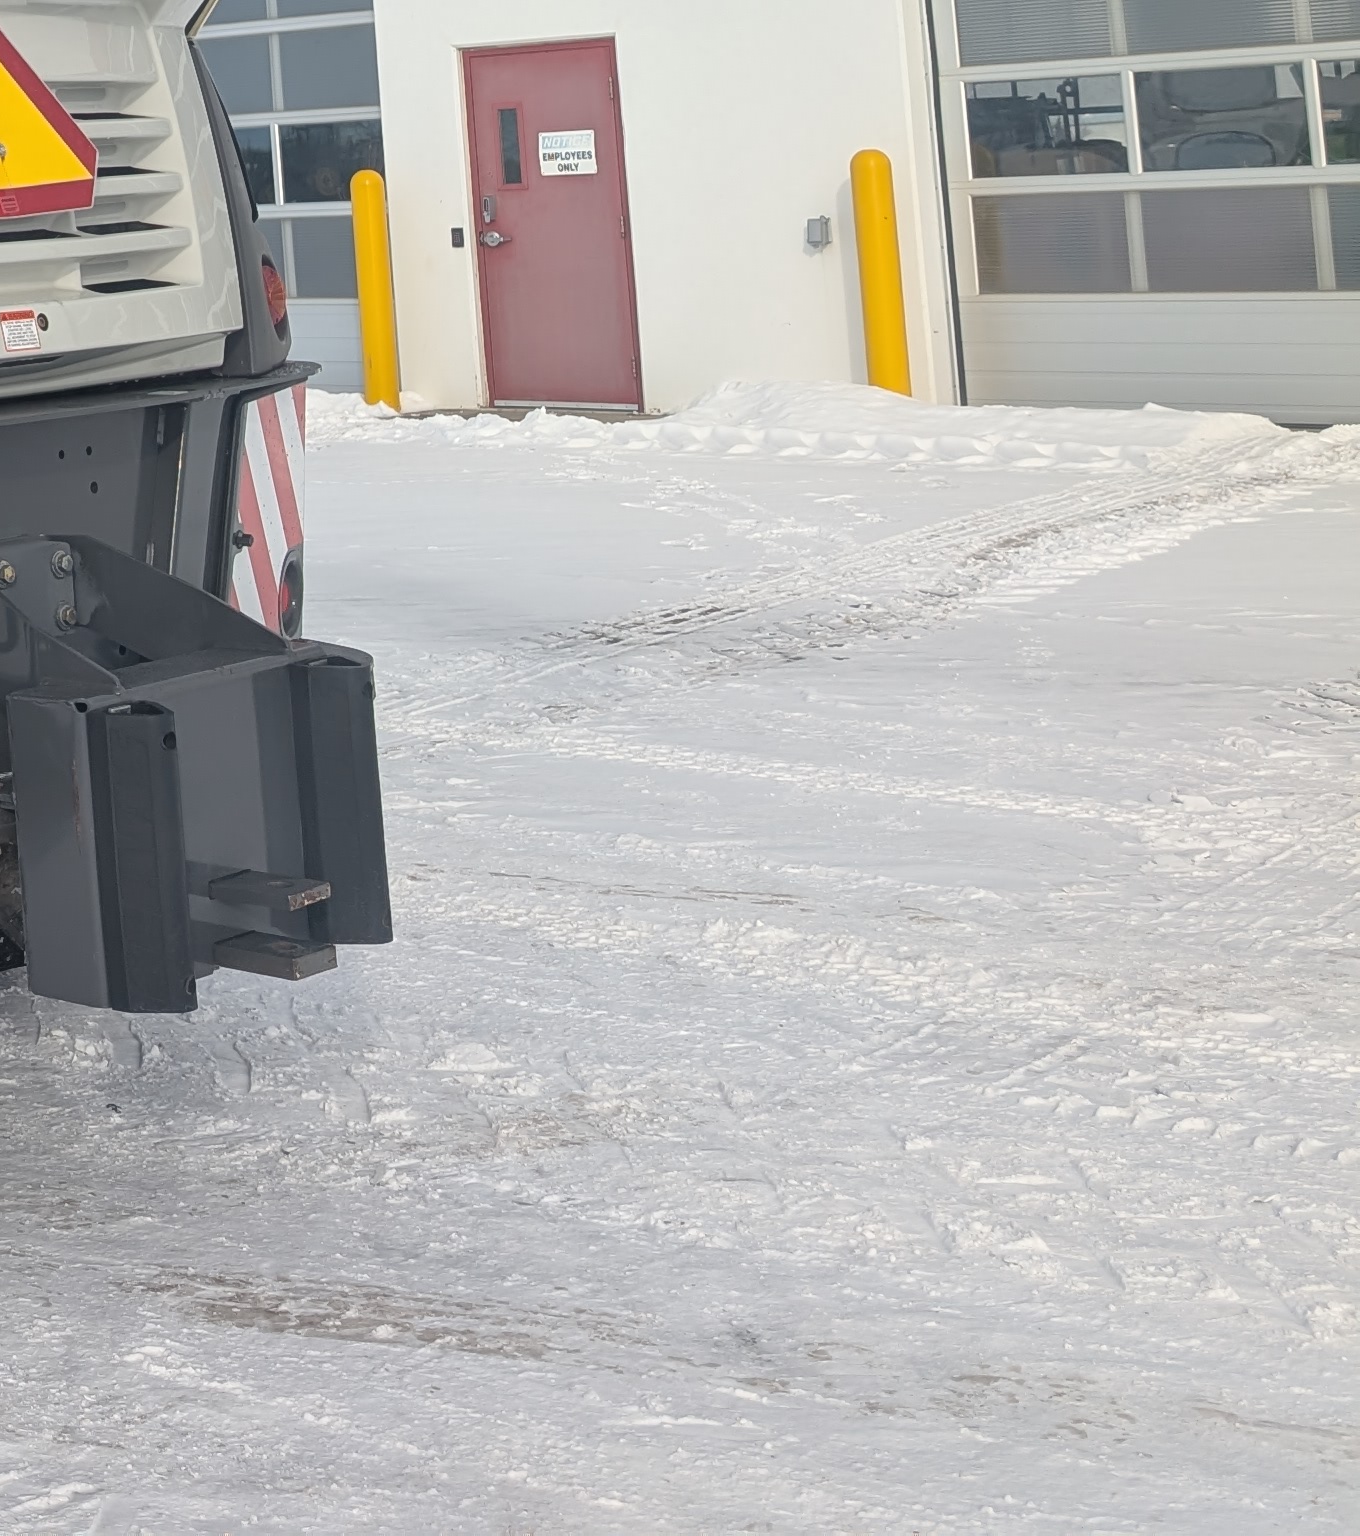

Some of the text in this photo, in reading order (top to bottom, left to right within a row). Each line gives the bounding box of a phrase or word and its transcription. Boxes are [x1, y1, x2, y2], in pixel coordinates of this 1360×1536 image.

[543, 135, 591, 148] NOTICE
[542, 150, 593, 162] EMPLOYEES
[557, 162, 579, 172] ONLY
